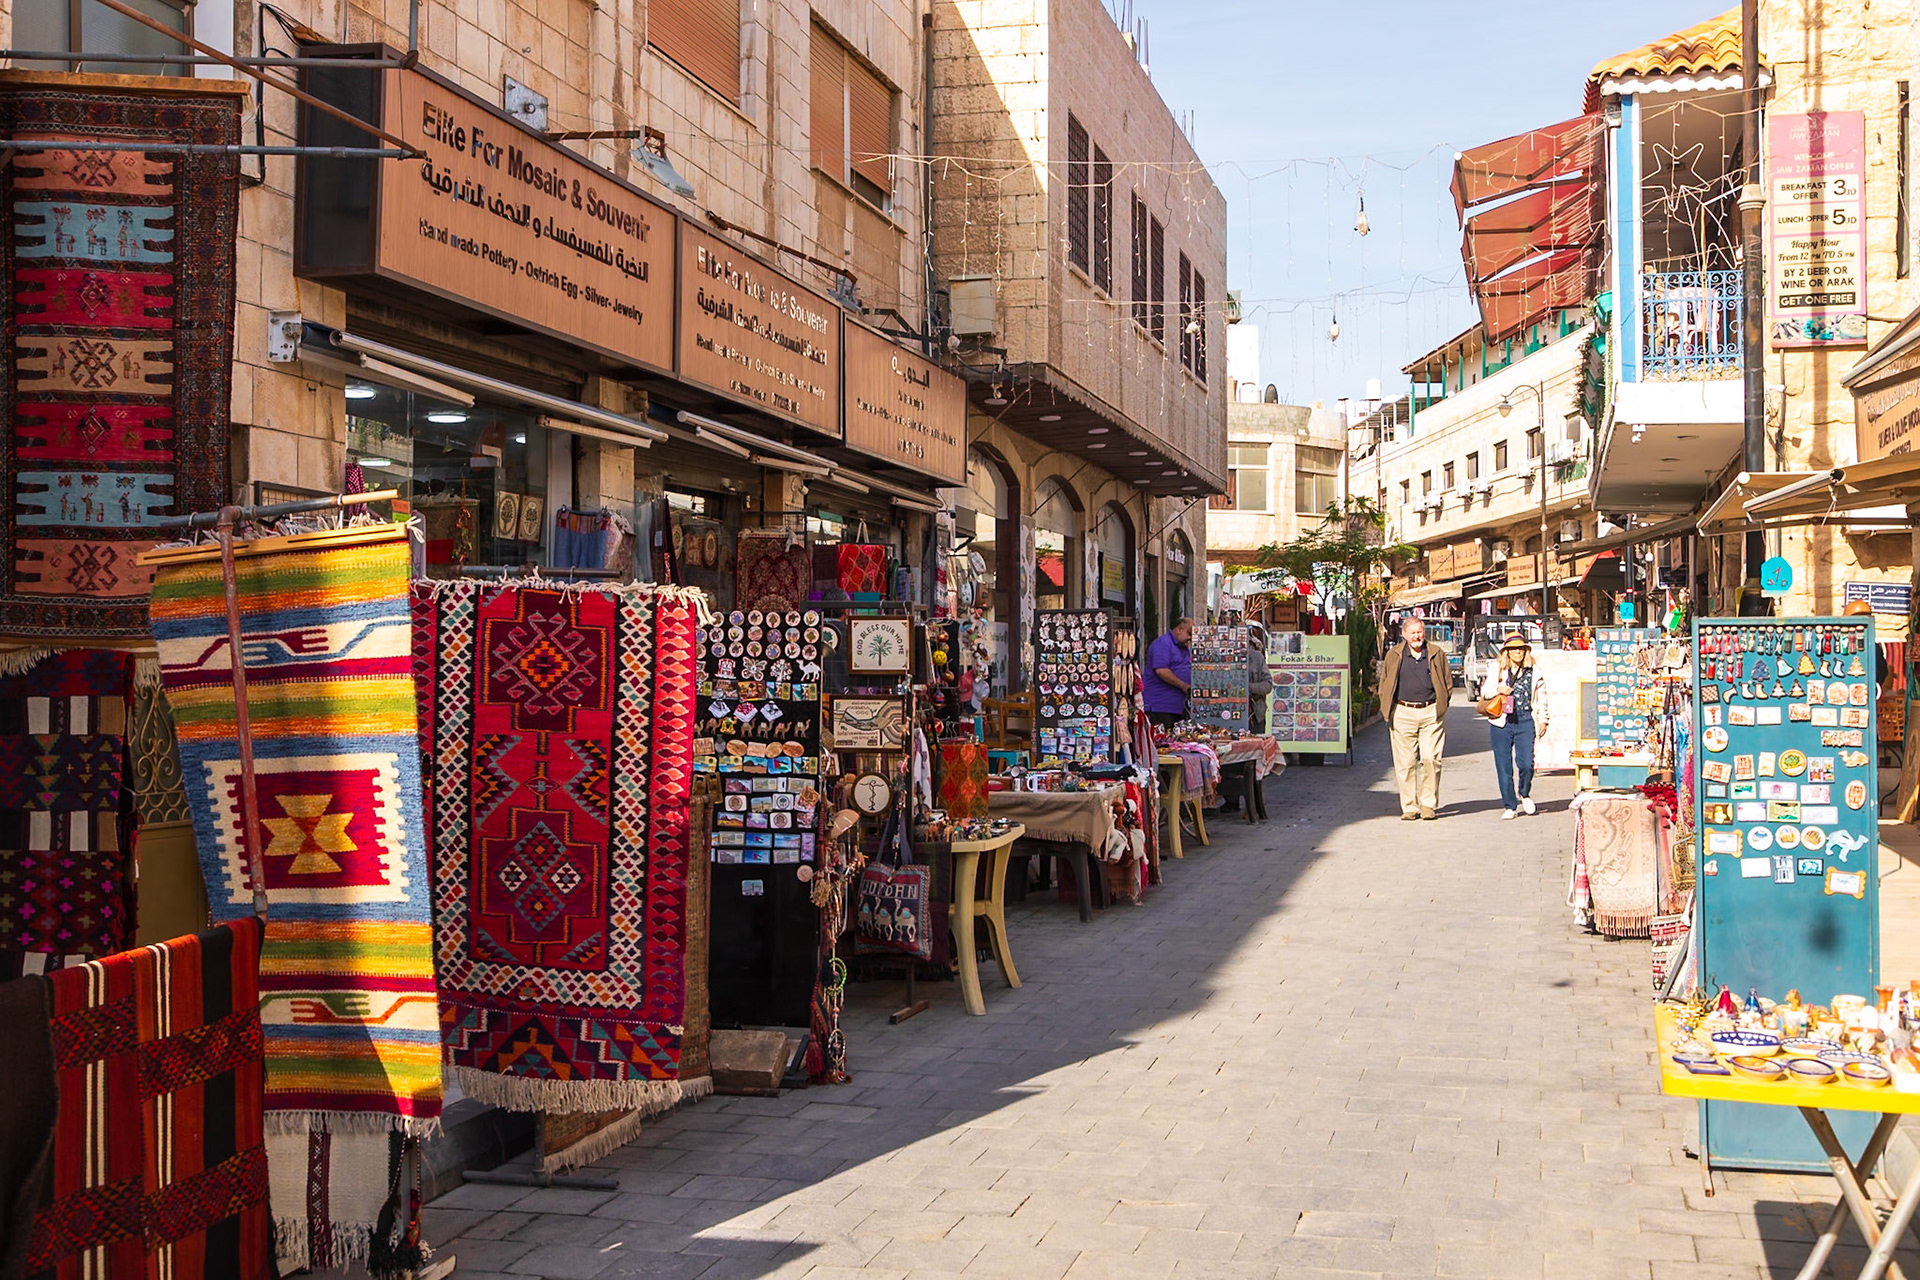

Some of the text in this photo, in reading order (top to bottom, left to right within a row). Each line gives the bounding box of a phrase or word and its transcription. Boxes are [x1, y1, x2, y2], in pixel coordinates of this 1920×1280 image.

[422, 100, 651, 244] Elite For Mosaic & Souvenir
[1781, 182, 1827, 192] BREAKFAST
[1833, 179, 1846, 196] 3
[1792, 191, 1819, 200] OFFER
[1778, 216, 1804, 224] LUNCH
[1805, 214, 1829, 222] OFFER
[1832, 208, 1846, 225] 5
[1791, 238, 1841, 250] Happy Hour
[1778, 254, 1799, 262] From
[1800, 252, 1809, 260] 12
[1837, 250, 1843, 258] 5
[419, 217, 449, 245] Hand
[450, 233, 480, 257] made
[481, 242, 518, 275] Pottery
[526, 260, 560, 289] Ostrich
[561, 275, 578, 300] Egg
[612, 298, 643, 326] Jewelry
[1784, 266, 1848, 278] BY 2 BEER OR
[697, 245, 722, 281] Elite
[724, 260, 743, 292] For
[789, 295, 829, 336] Souvenir
[1780, 277, 1855, 289] WINE OR ARAK
[1780, 293, 1853, 306] GET ONE FREE
[860, 623, 880, 640] BLESS
[880, 624, 896, 636] OUR
[894, 633, 905, 655] HOME
[862, 881, 918, 899] JORDAN
